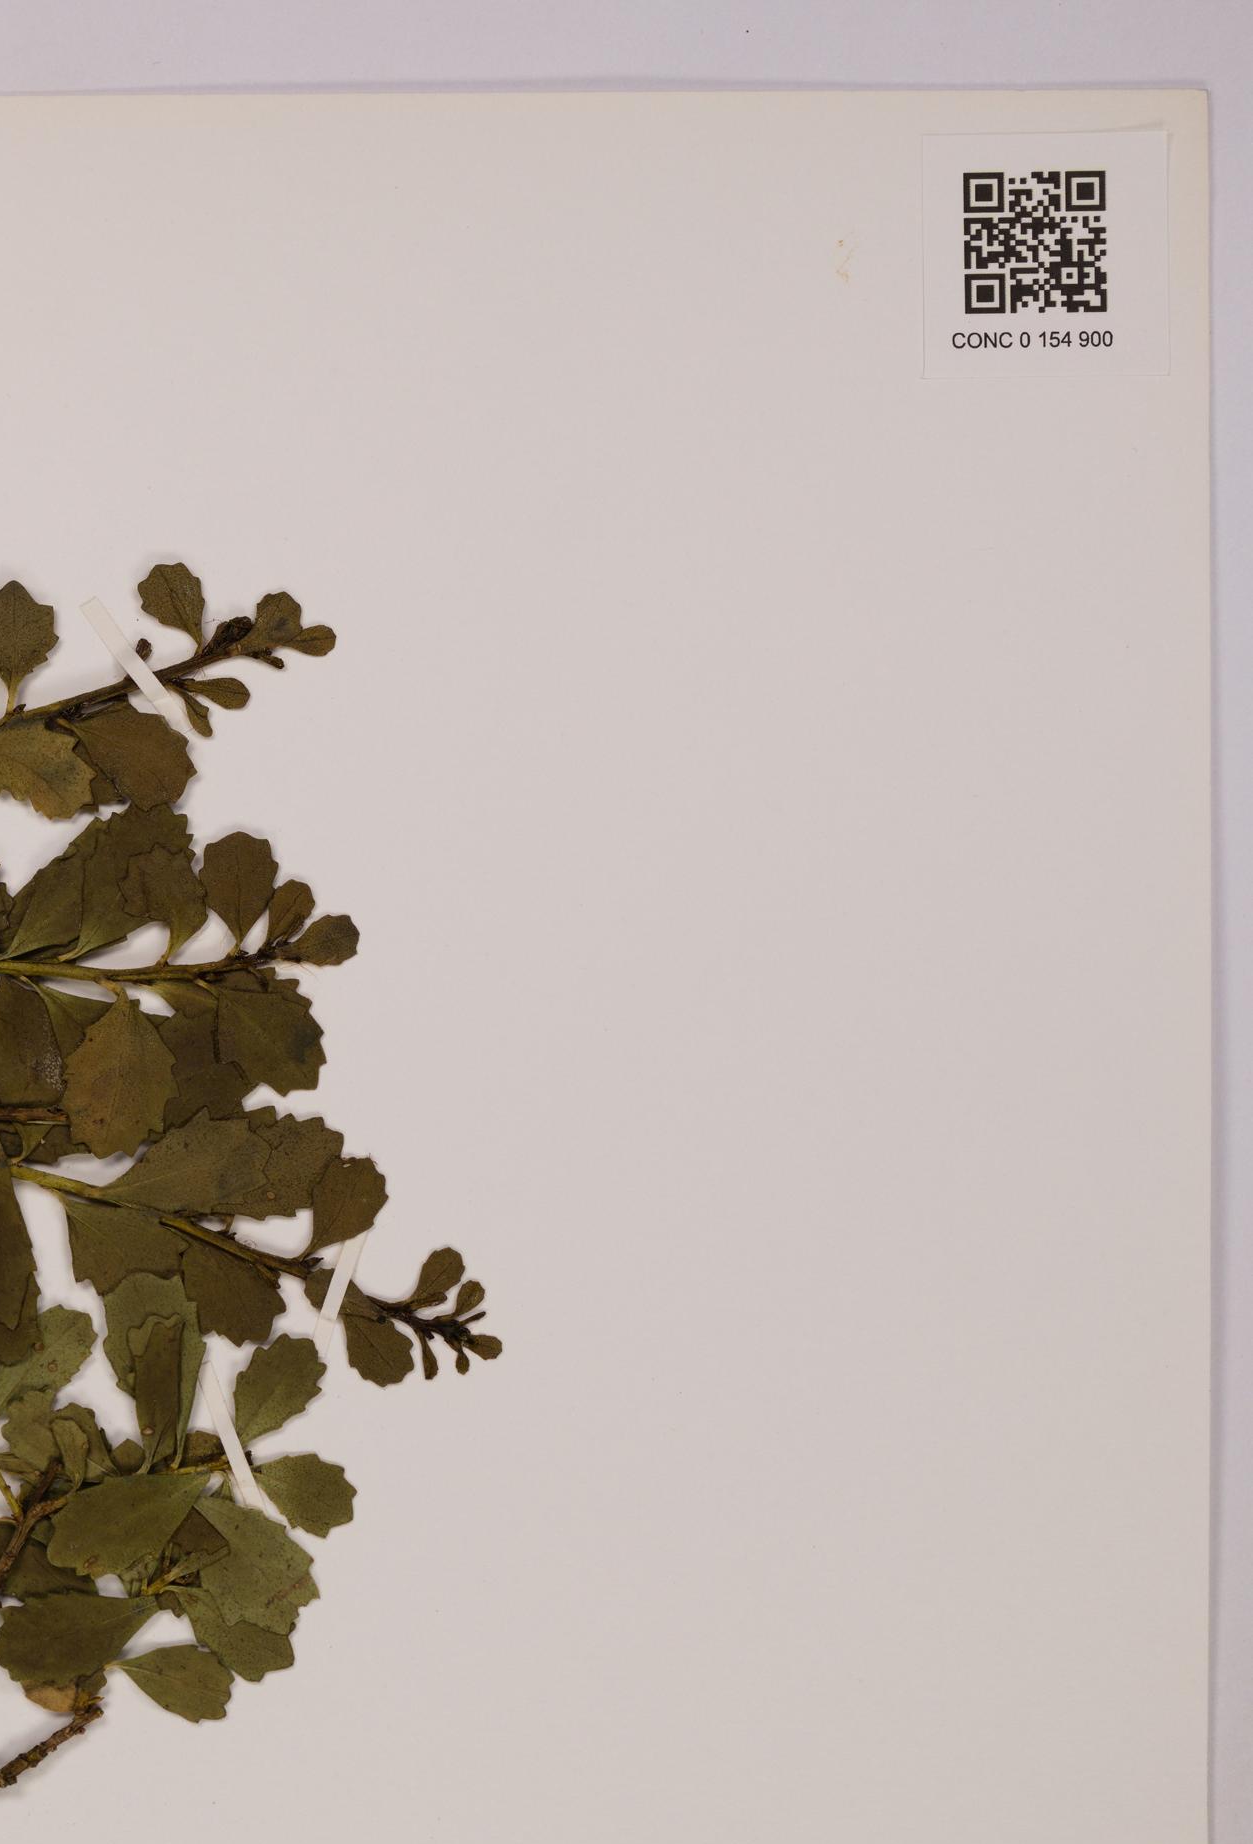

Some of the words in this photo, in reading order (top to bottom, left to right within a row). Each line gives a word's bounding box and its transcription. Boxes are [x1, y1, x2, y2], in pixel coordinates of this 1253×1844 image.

[951, 331, 1013, 350] CONC
[1019, 331, 1031, 349] 0
[1038, 330, 1073, 348] 154
[1078, 330, 1114, 348] 900
